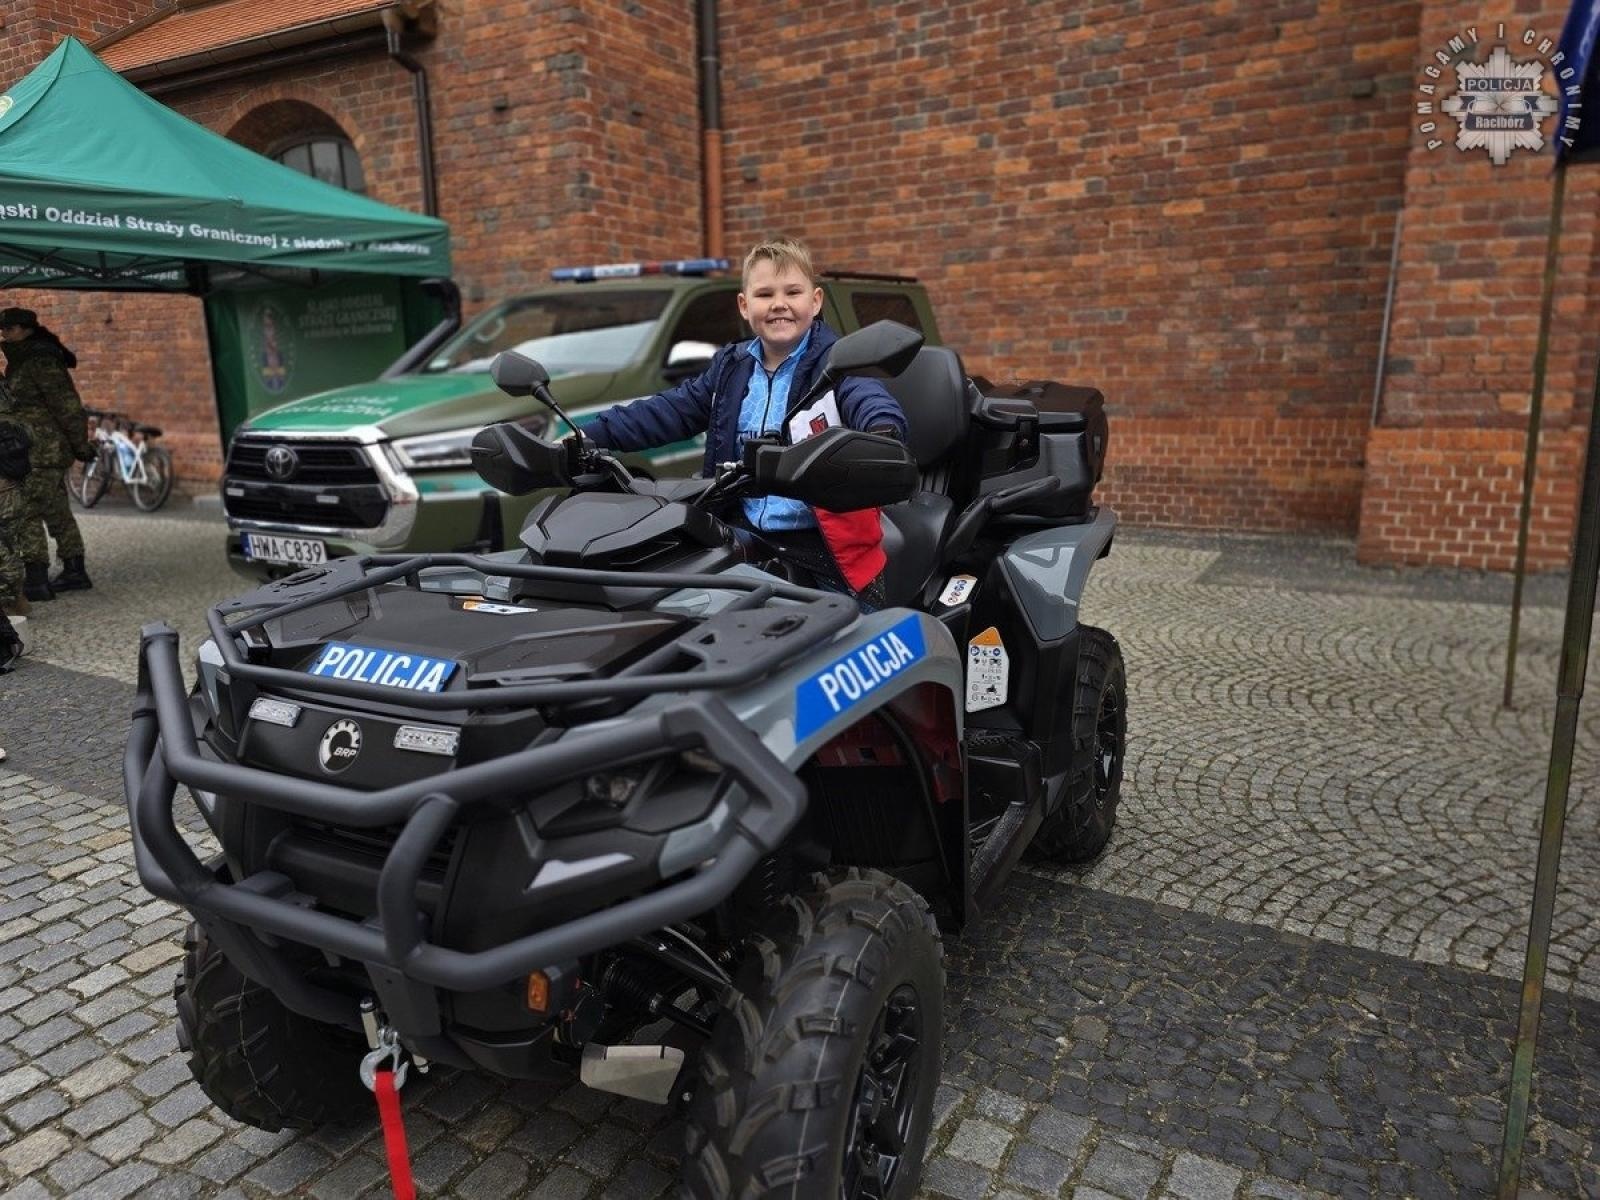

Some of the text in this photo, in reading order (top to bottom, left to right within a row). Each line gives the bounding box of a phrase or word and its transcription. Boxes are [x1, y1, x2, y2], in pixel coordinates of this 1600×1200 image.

[125, 216, 184, 237] Straży
[189, 224, 277, 248] Granicznej
[281, 239, 290, 247] z
[251, 535, 322, 563] HWA C839
[314, 646, 446, 692] POLICJA
[818, 631, 914, 712] POLICJA
[333, 747, 356, 757] BRP
